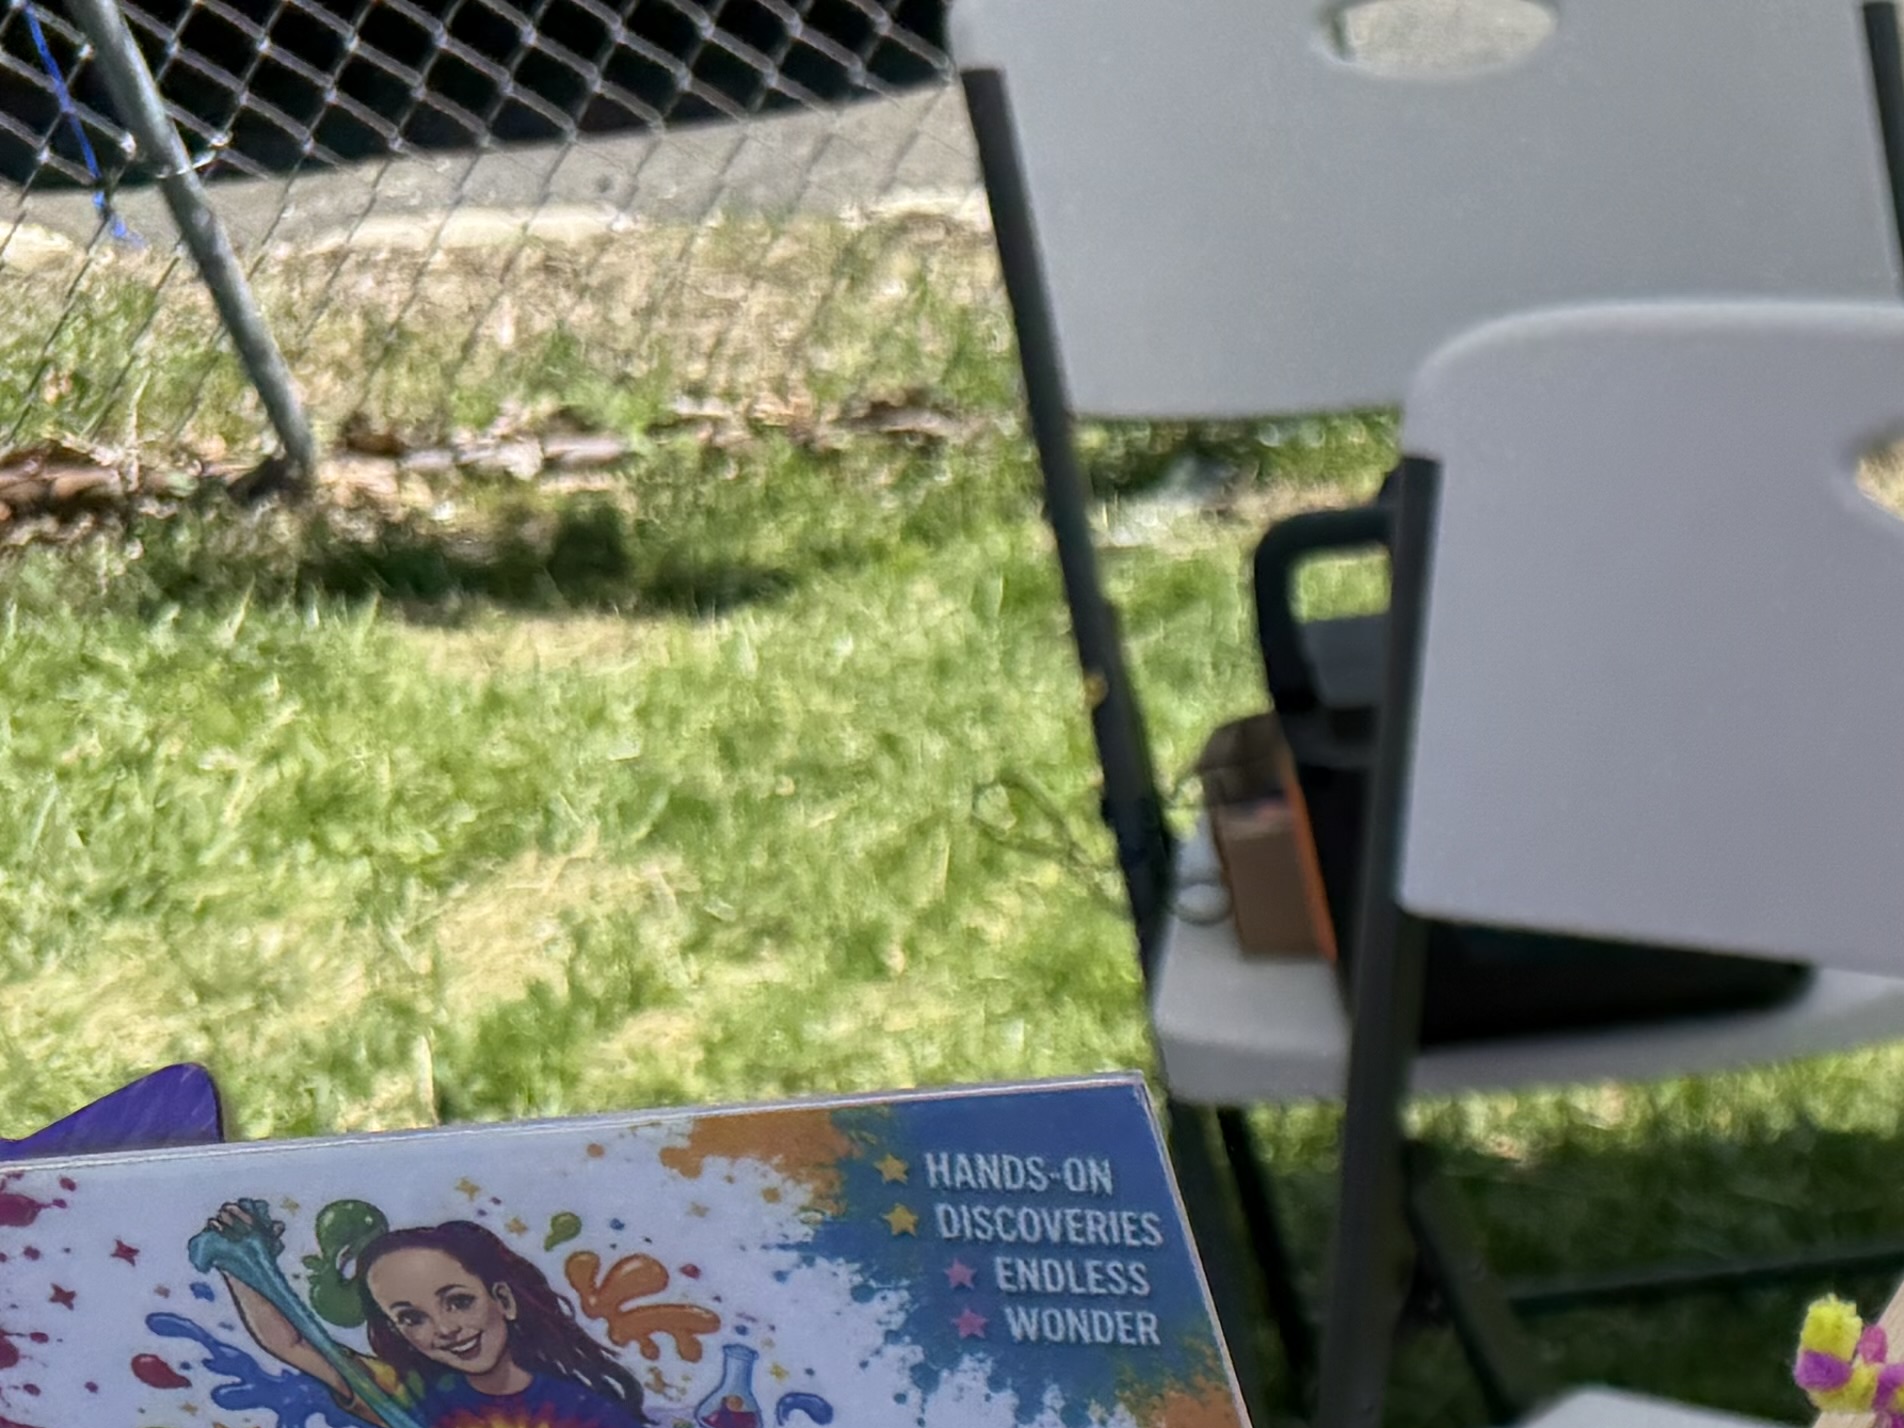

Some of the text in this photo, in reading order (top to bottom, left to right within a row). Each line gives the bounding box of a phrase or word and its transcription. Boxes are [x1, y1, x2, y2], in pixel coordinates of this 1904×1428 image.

[925, 1153, 1113, 1197] HANDS-ON
[935, 1204, 1163, 1247] DISCOVERIES
[994, 1256, 1150, 1297] ENDLESS
[1006, 1307, 1161, 1346] WONDER
